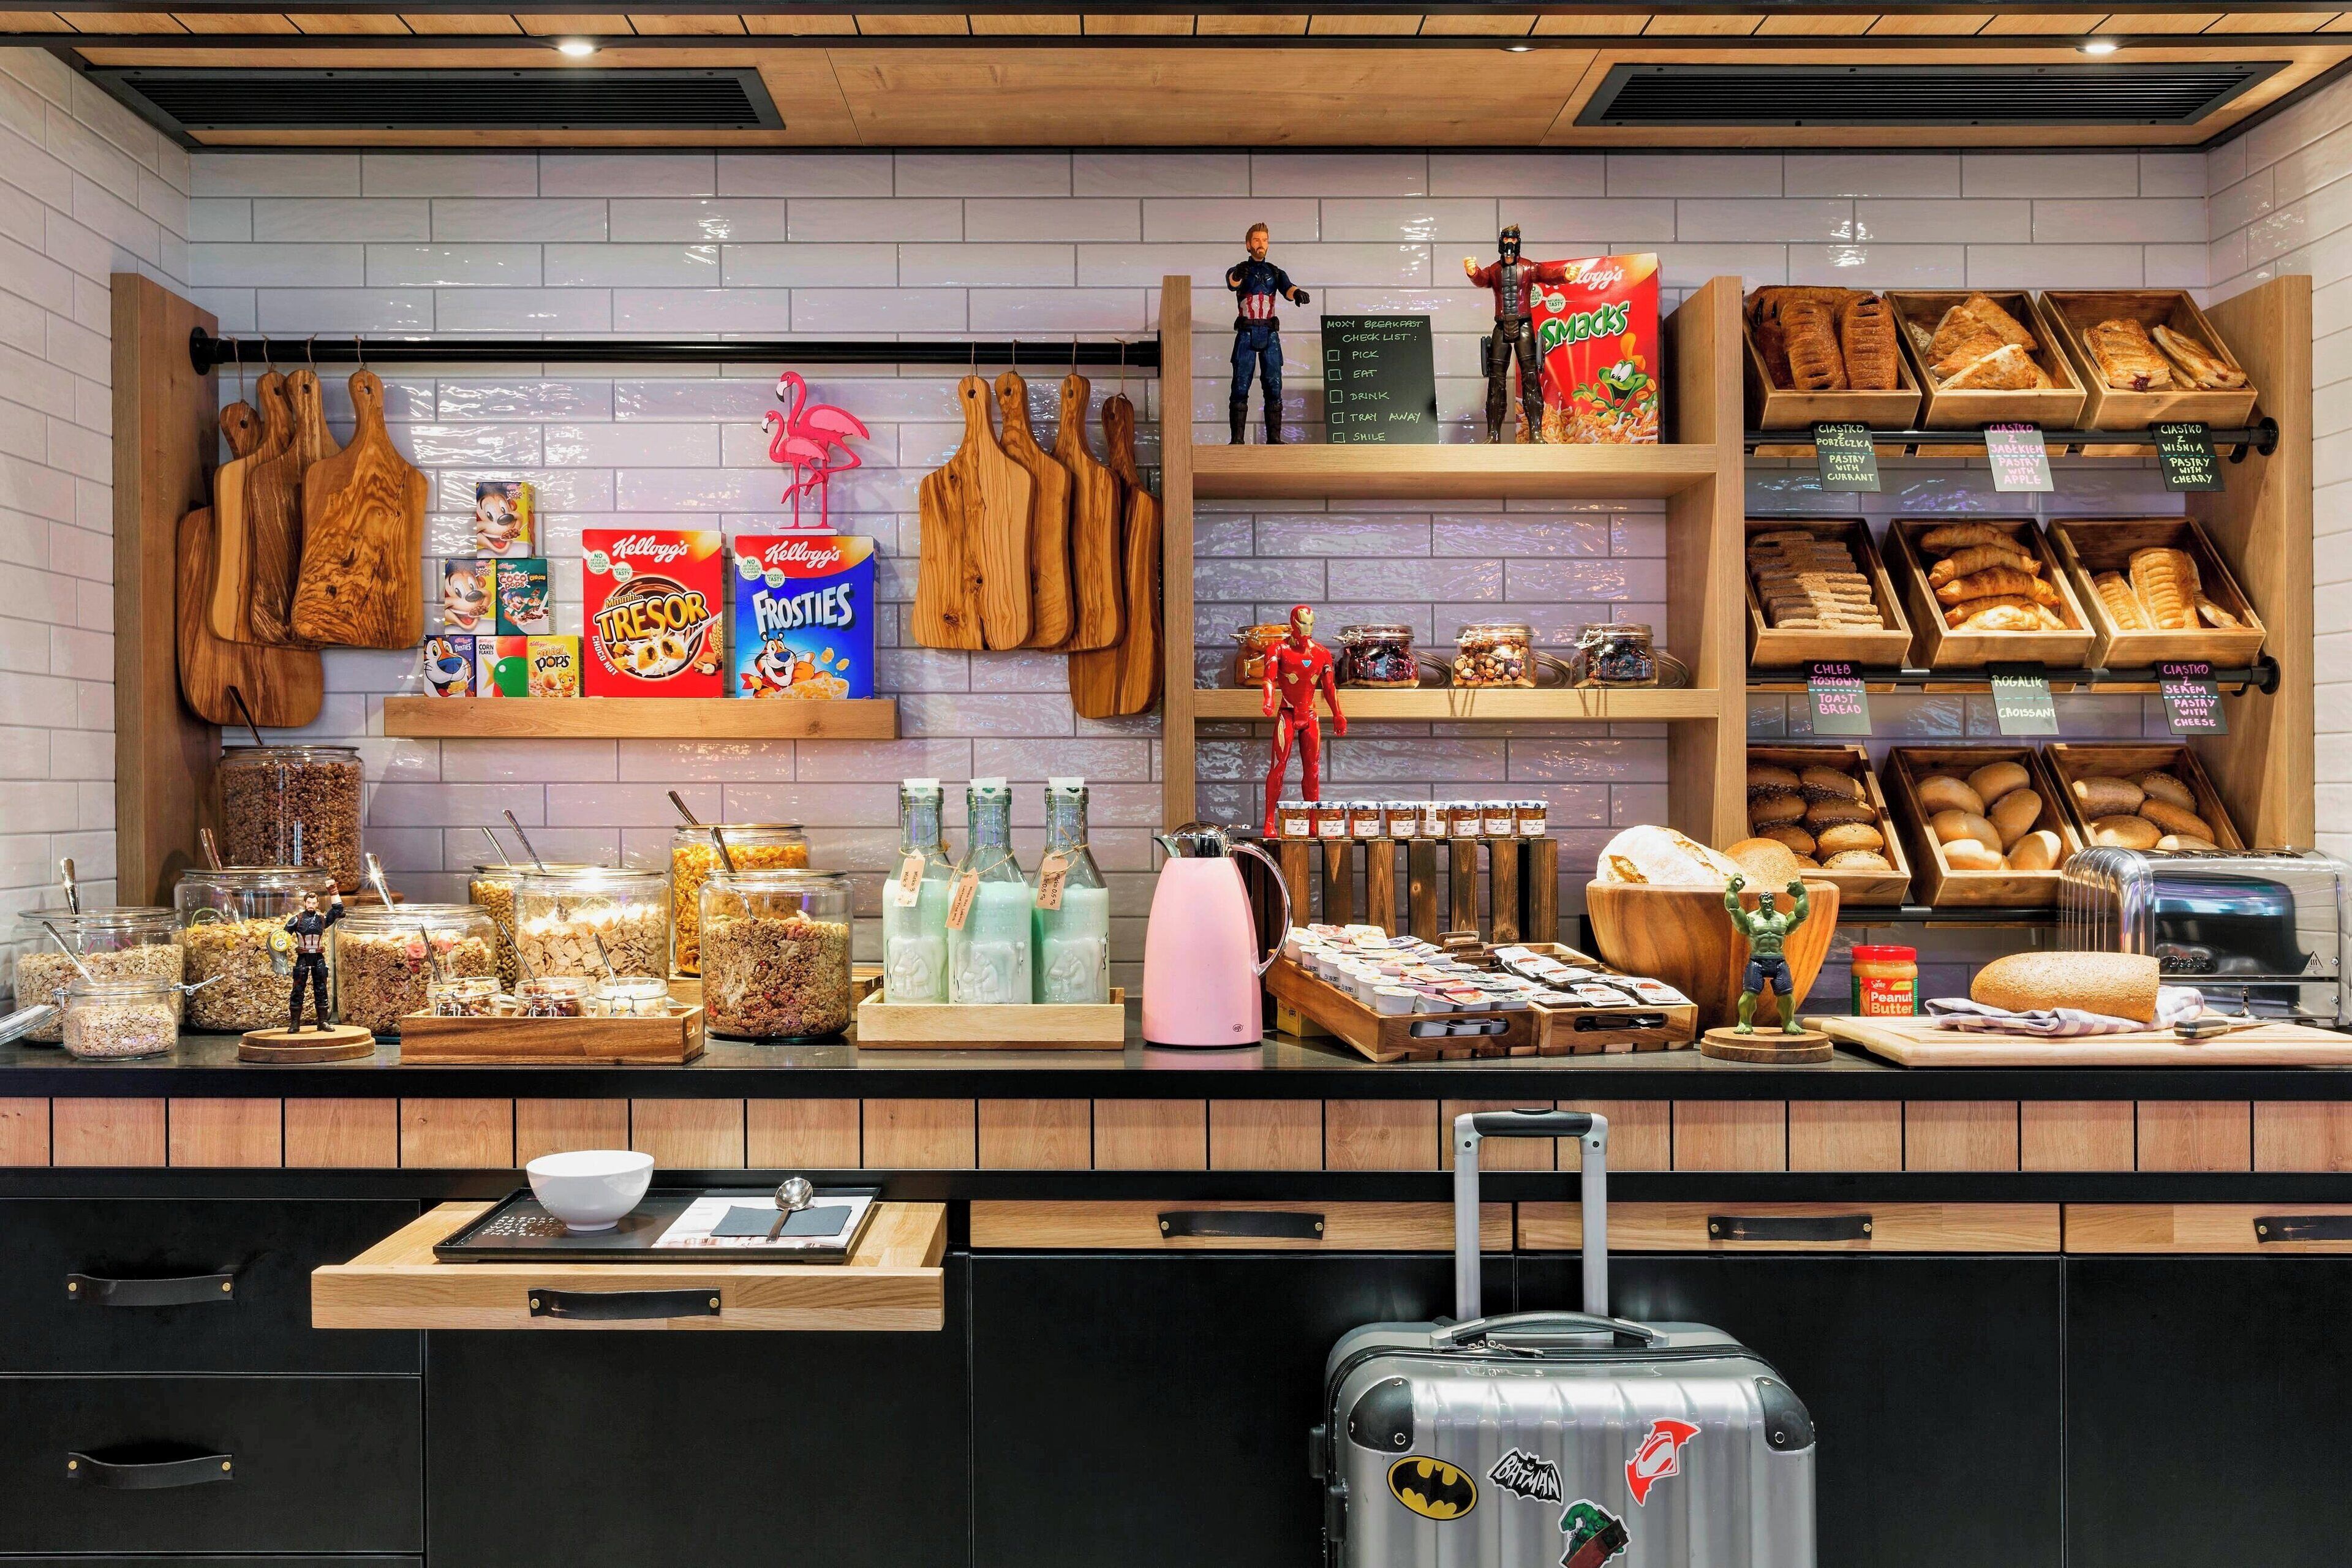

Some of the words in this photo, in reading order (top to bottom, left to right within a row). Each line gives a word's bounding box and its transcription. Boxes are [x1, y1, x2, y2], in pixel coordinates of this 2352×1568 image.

[1352, 350, 1379, 360] PICK
[1353, 370, 1377, 379] EAT
[1350, 391, 1390, 401] DRINK
[1350, 413, 1377, 421] TRAY
[1389, 412, 1421, 423] AWAY
[1819, 424, 1864, 434] CIASTKO
[1990, 423, 2034, 434] CIASTKO
[2161, 424, 2202, 434] CIASTKO
[1353, 432, 1385, 442] SMILE
[2008, 435, 2017, 443] Z
[1817, 439, 1872, 452] PORZECZKĄ
[2162, 442, 2204, 453] WIŚNIĄ
[1829, 455, 1865, 464] PASTRY
[1999, 458, 2040, 467] PASTRY
[2169, 458, 2209, 467] PASTRY
[1827, 473, 1874, 482] CURRANT
[2004, 475, 2041, 484] APPLE
[2173, 474, 2212, 484] CHERRY
[612, 534, 692, 563] Kellogg's
[764, 541, 844, 569] Kellogg's
[500, 575, 527, 584] COCO
[505, 582, 525, 590] pops
[752, 583, 853, 635] FROSTIES
[595, 592, 709, 642] TRESOR
[592, 635, 606, 663] CHOCO
[604, 660, 619, 676] NUT
[1814, 664, 1851, 674] CHLEB
[2163, 665, 2209, 675] CIASTKO
[1811, 676, 1860, 687] TOSTOWY
[1992, 675, 2043, 688] ROGALIK
[2183, 676, 2192, 686] Z
[2166, 685, 2207, 695] SEREM
[1818, 694, 1857, 703] TOAST
[2174, 699, 2215, 707] PASTRY
[1819, 704, 1861, 715] BREAD
[1999, 707, 2056, 718] CROISSANT
[1871, 992, 1912, 1003] Peanut
[1871, 1002, 1913, 1014] Butter
[1493, 1455, 1561, 1499] BATMAN
